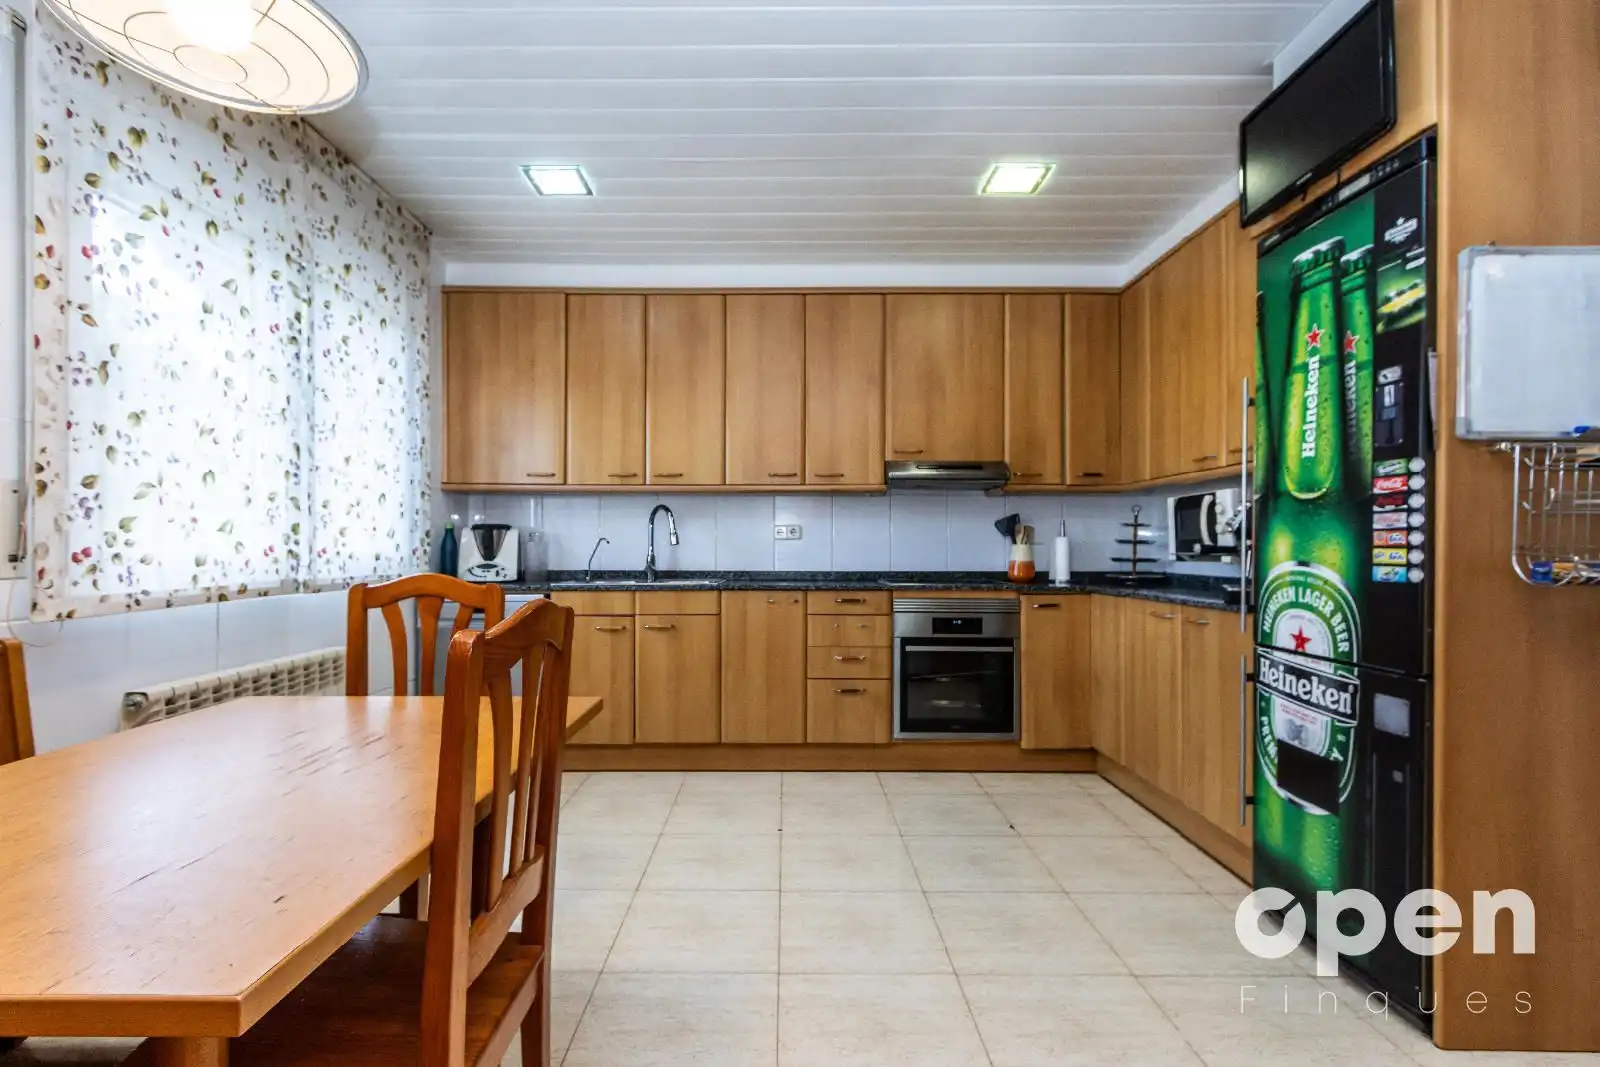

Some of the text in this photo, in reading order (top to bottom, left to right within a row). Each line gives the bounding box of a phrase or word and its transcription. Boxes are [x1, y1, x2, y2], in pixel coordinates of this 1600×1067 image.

[1302, 355, 1320, 458] Heineken
[1263, 586, 1350, 653] HEINEKEN LAGER BEER
[1260, 657, 1353, 715] Heineken
